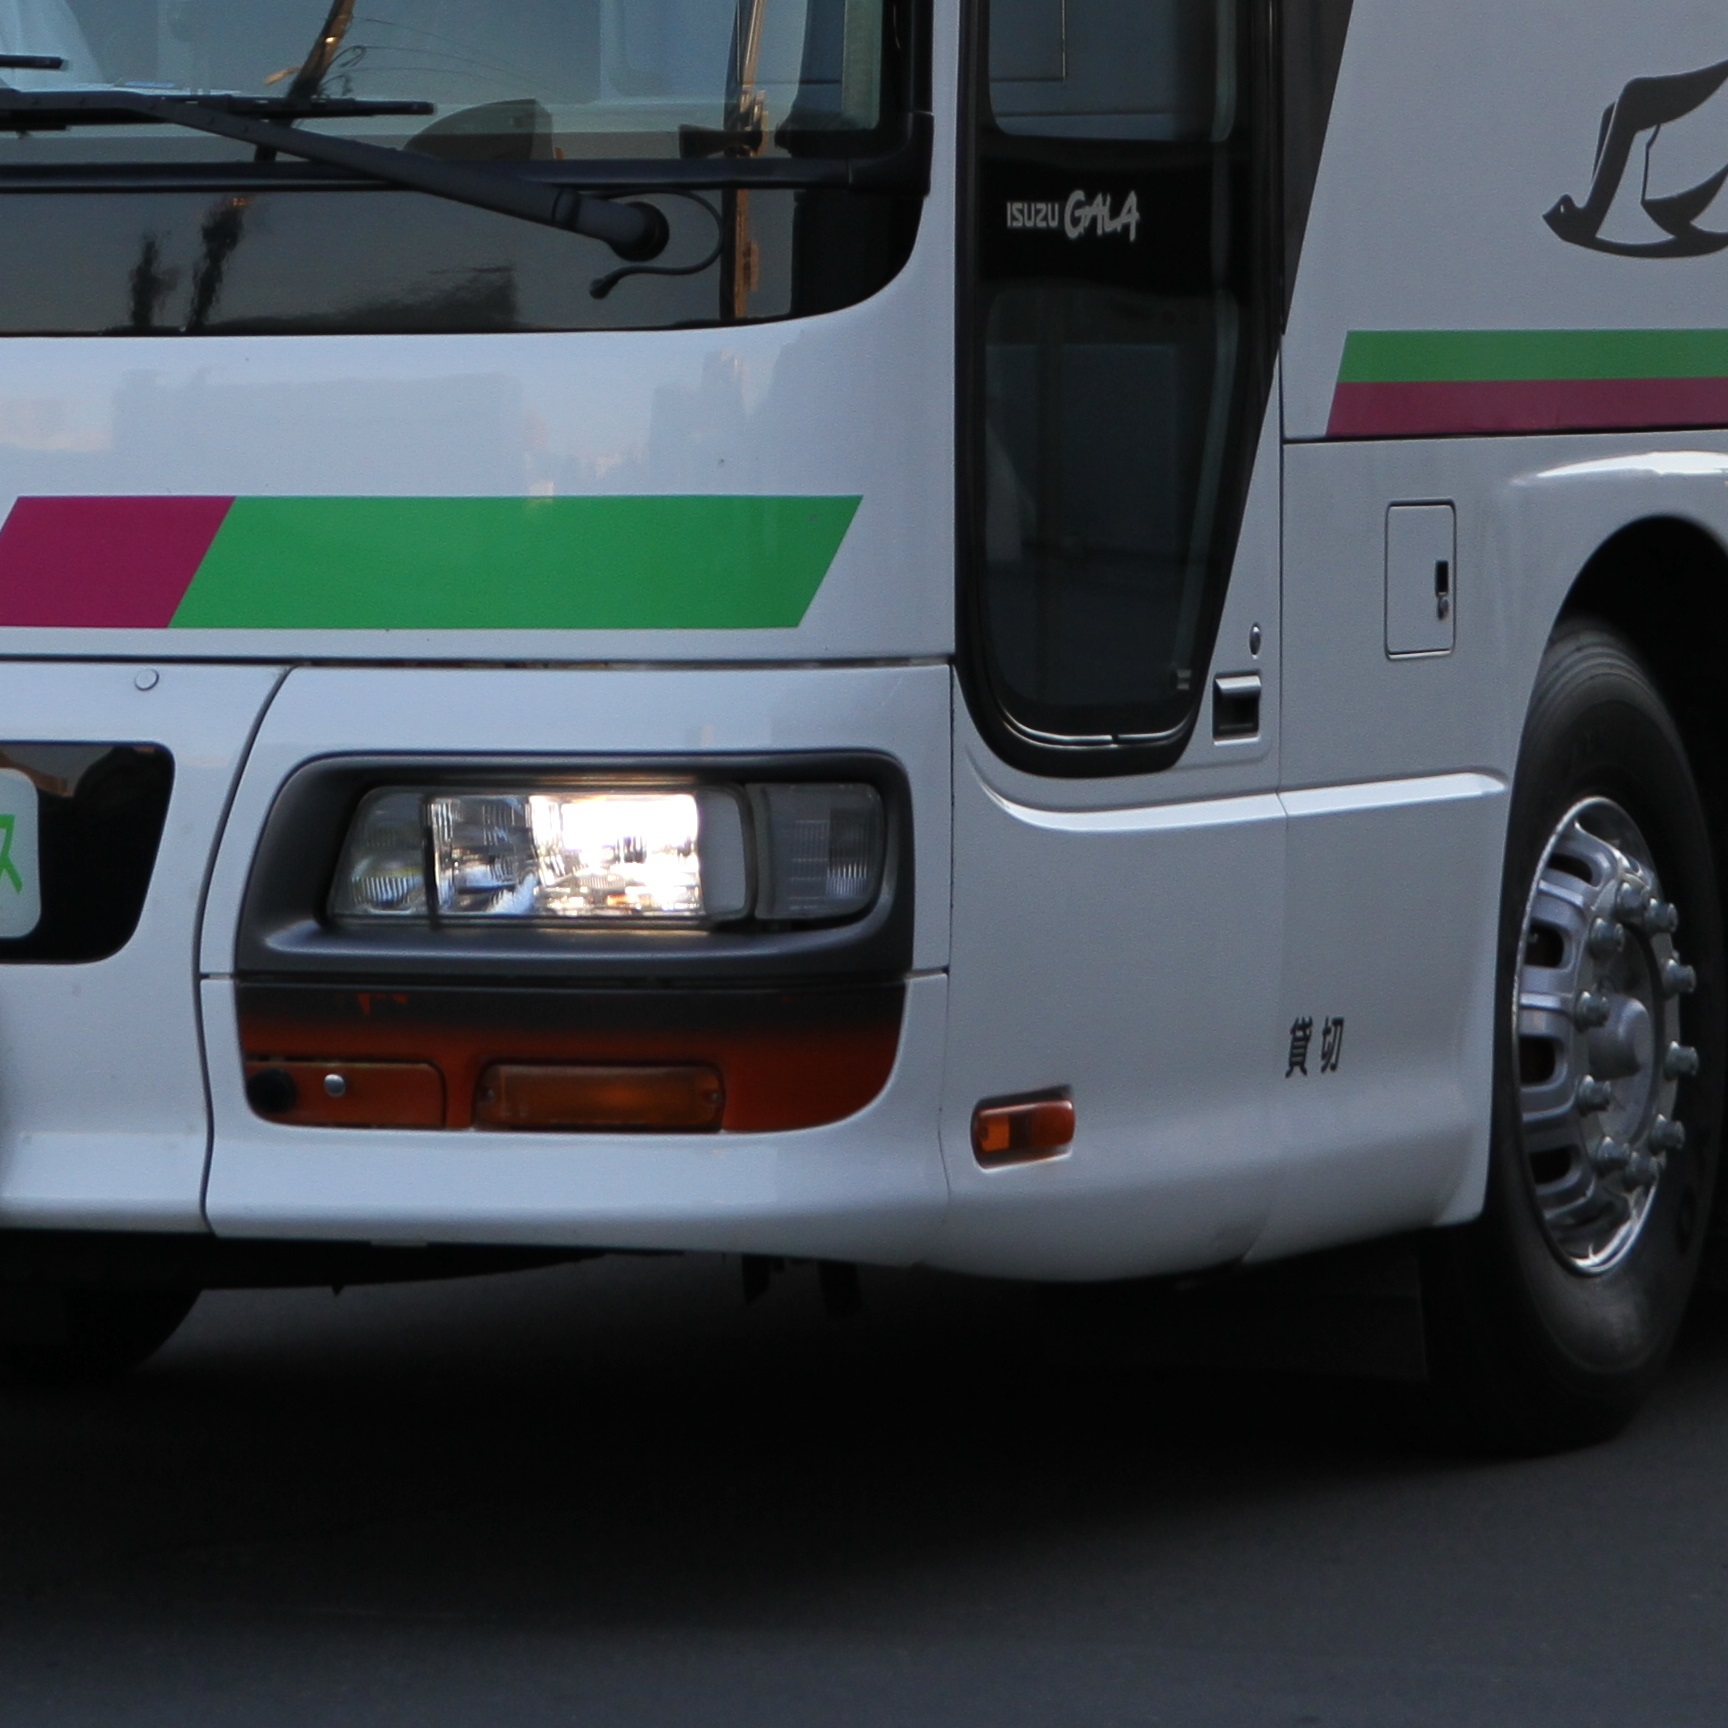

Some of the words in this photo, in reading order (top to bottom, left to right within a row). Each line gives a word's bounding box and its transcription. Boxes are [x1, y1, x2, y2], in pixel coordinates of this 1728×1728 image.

[1006, 202, 1059, 228] ISUZU
[1064, 189, 1140, 242] GALA
[1285, 1016, 1345, 1079] 貸切
